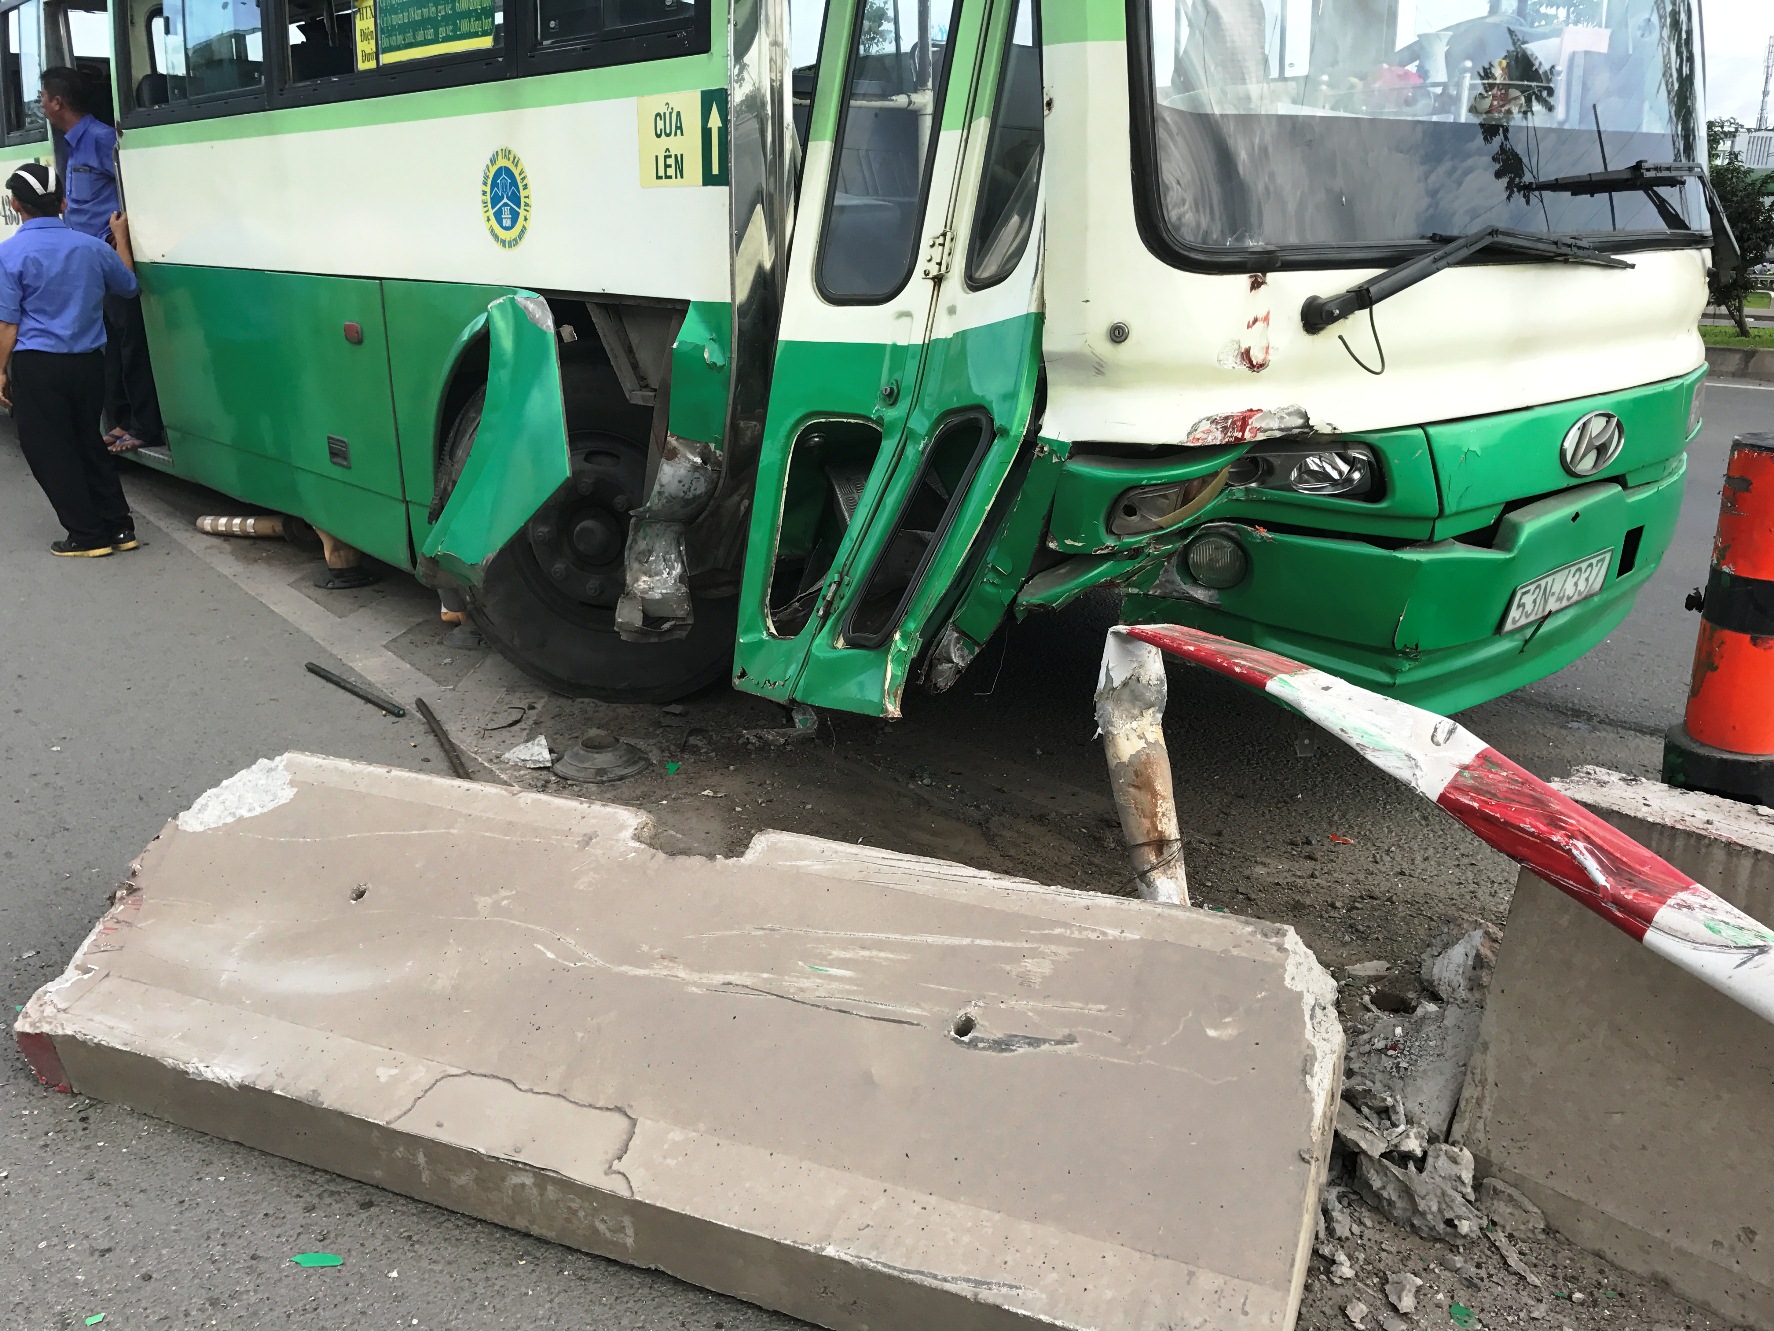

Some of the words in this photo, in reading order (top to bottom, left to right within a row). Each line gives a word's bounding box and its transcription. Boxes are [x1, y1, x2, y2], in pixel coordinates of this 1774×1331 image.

[654, 102, 684, 138] CỬA
[500, 146, 512, 162] TÁC
[655, 148, 684, 180] LÊN
[1512, 556, 1606, 626] 53N-4337
